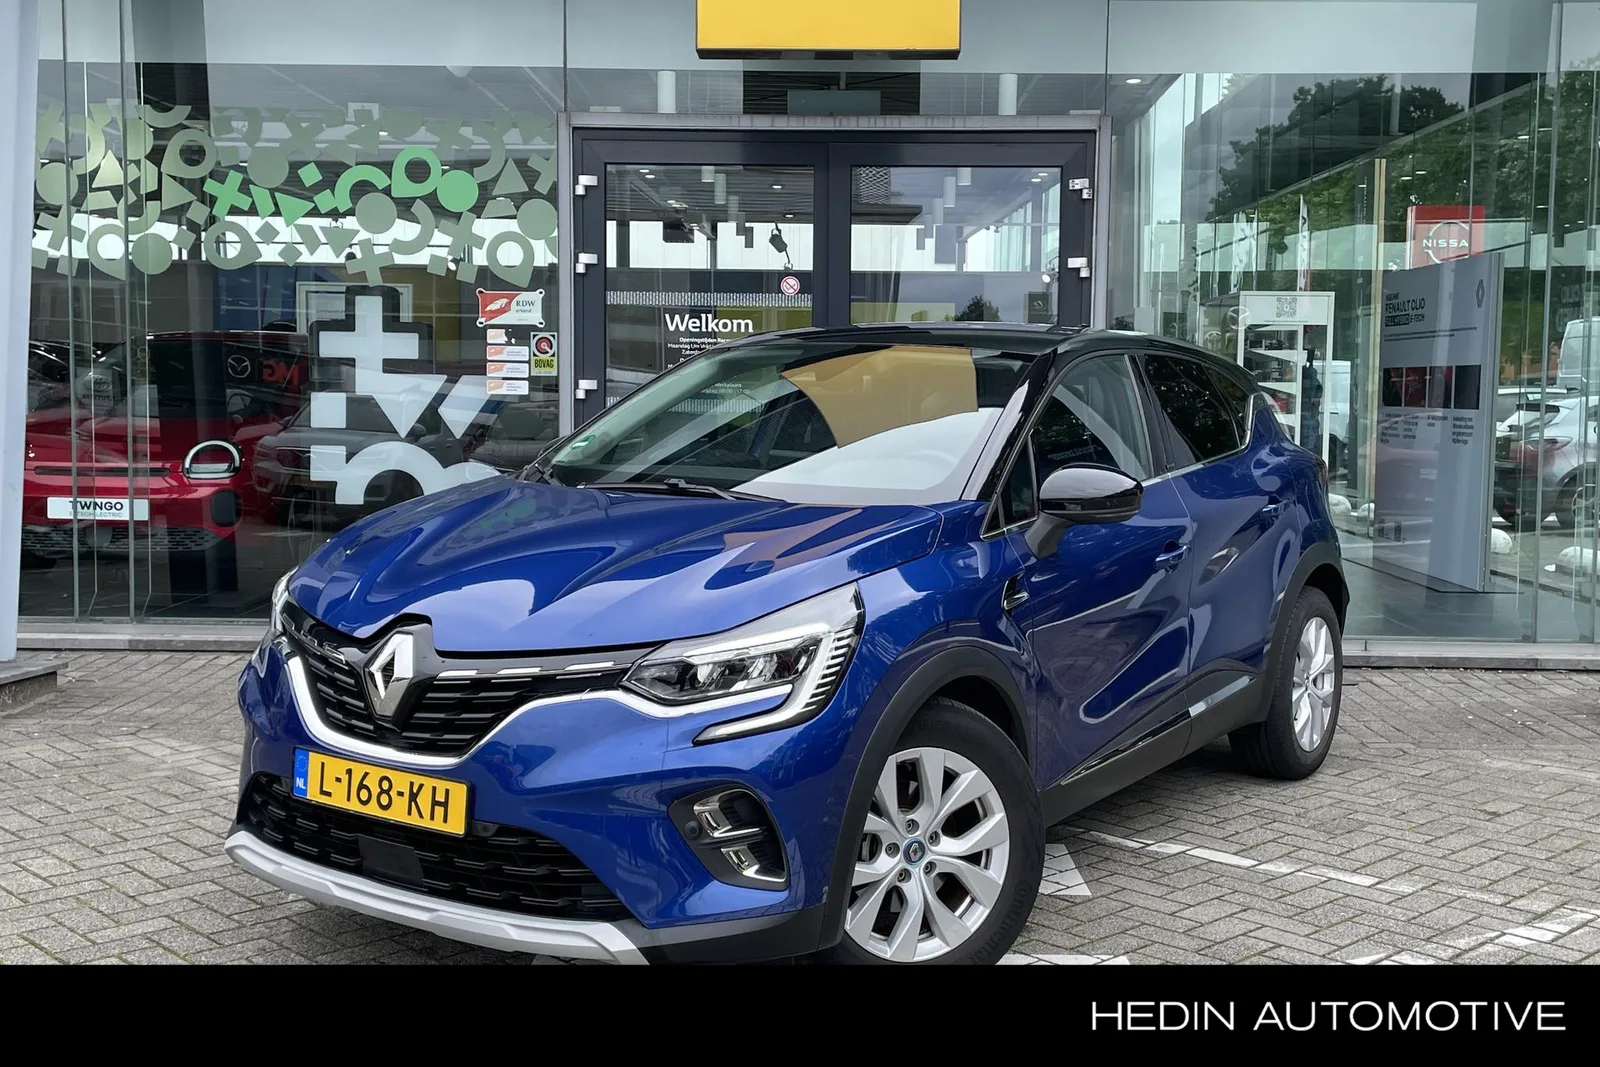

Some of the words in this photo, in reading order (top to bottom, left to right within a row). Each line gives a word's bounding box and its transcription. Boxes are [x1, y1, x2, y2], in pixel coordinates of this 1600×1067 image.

[1422, 239, 1469, 248] NISSA
[515, 299, 536, 307] RDW
[1385, 300, 1411, 314] RENAULT
[1411, 297, 1426, 311] CLIO
[664, 313, 754, 333] Welkom
[534, 358, 554, 369] BOVAG
[295, 777, 306, 790] NL
[318, 761, 450, 824] L-168-KH
